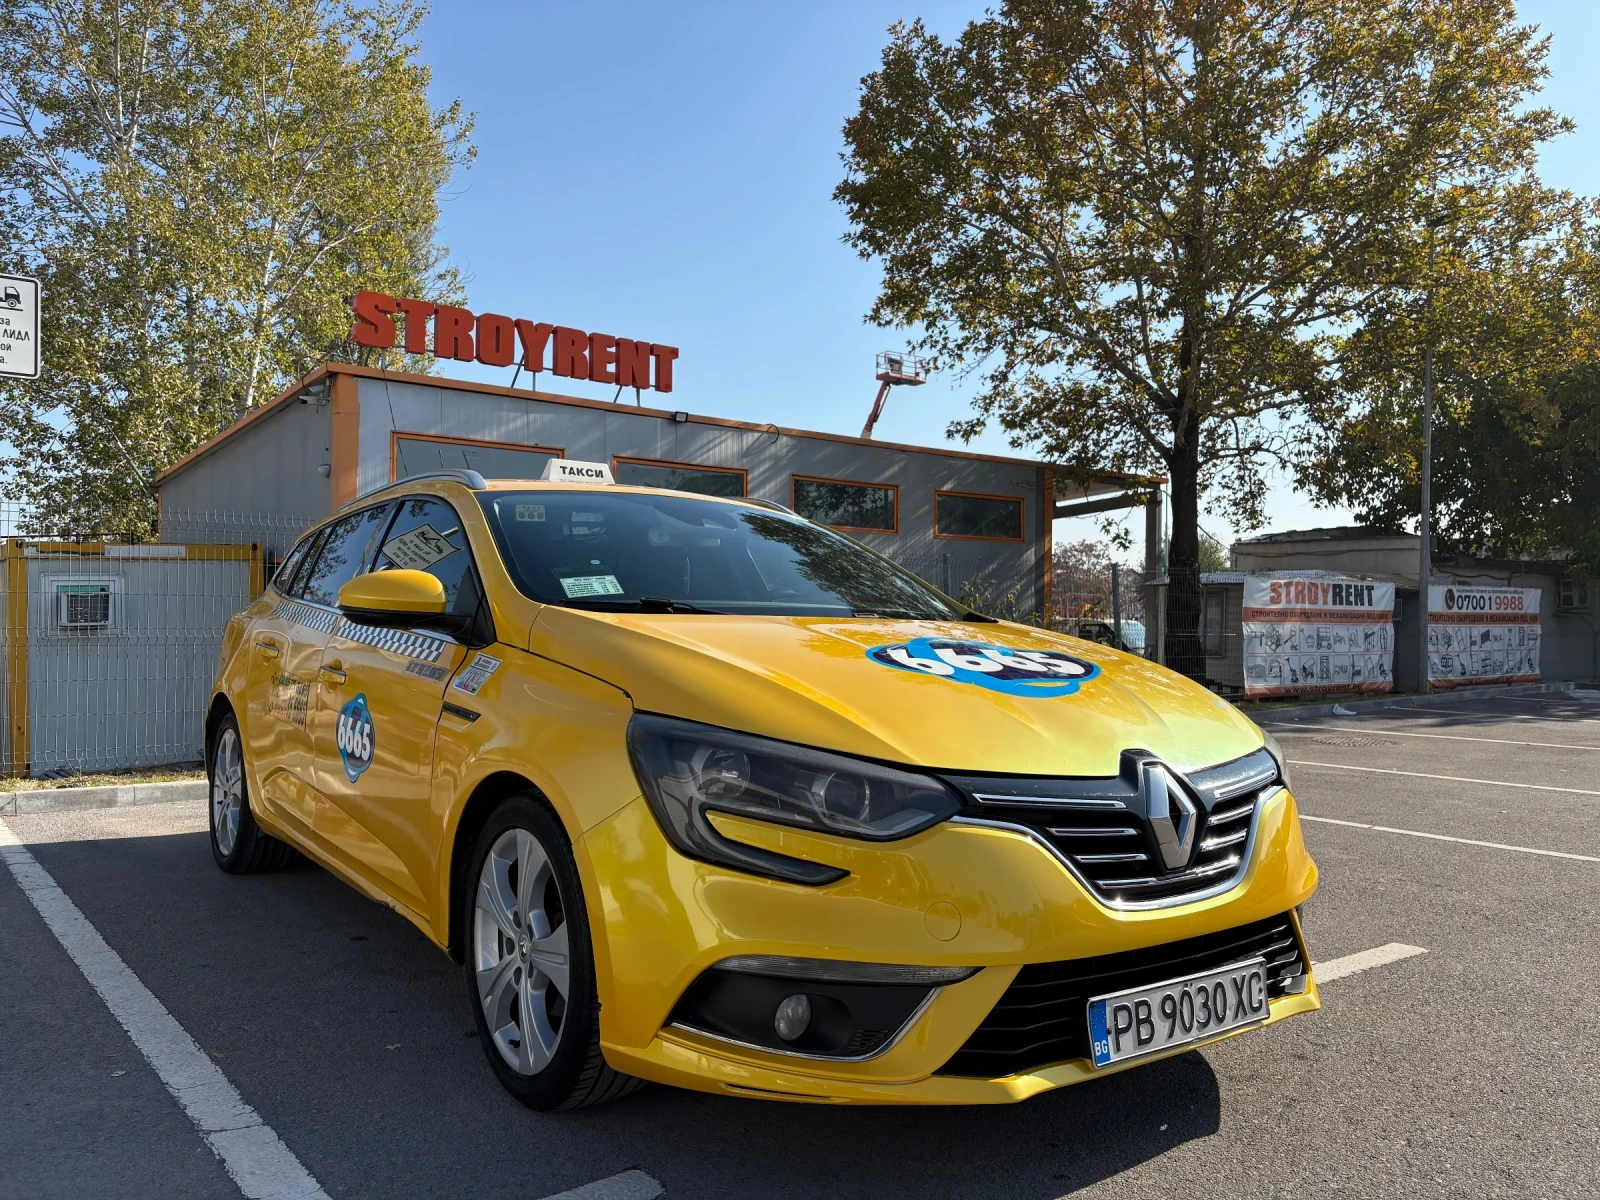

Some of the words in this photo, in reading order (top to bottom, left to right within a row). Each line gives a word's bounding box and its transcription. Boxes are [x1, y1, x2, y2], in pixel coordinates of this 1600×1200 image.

[2, 328, 30, 341] ЛИДЛ
[352, 290, 679, 392] STROYRENT
[560, 466, 604, 478] ТАКСИ
[1269, 580, 1375, 606] STROYRENT
[1252, 610, 1288, 618] СТРОИТЕЛНО
[1290, 611, 1322, 619] ОБОРУДВАНЕ
[887, 648, 1085, 676] 6665
[1284, 684, 1363, 693] www.stroyrent.bg
[337, 714, 371, 761] 6665
[1113, 998, 1155, 1053] PB
[1161, 980, 1228, 1040] 9030
[1094, 1041, 1108, 1056] BG
